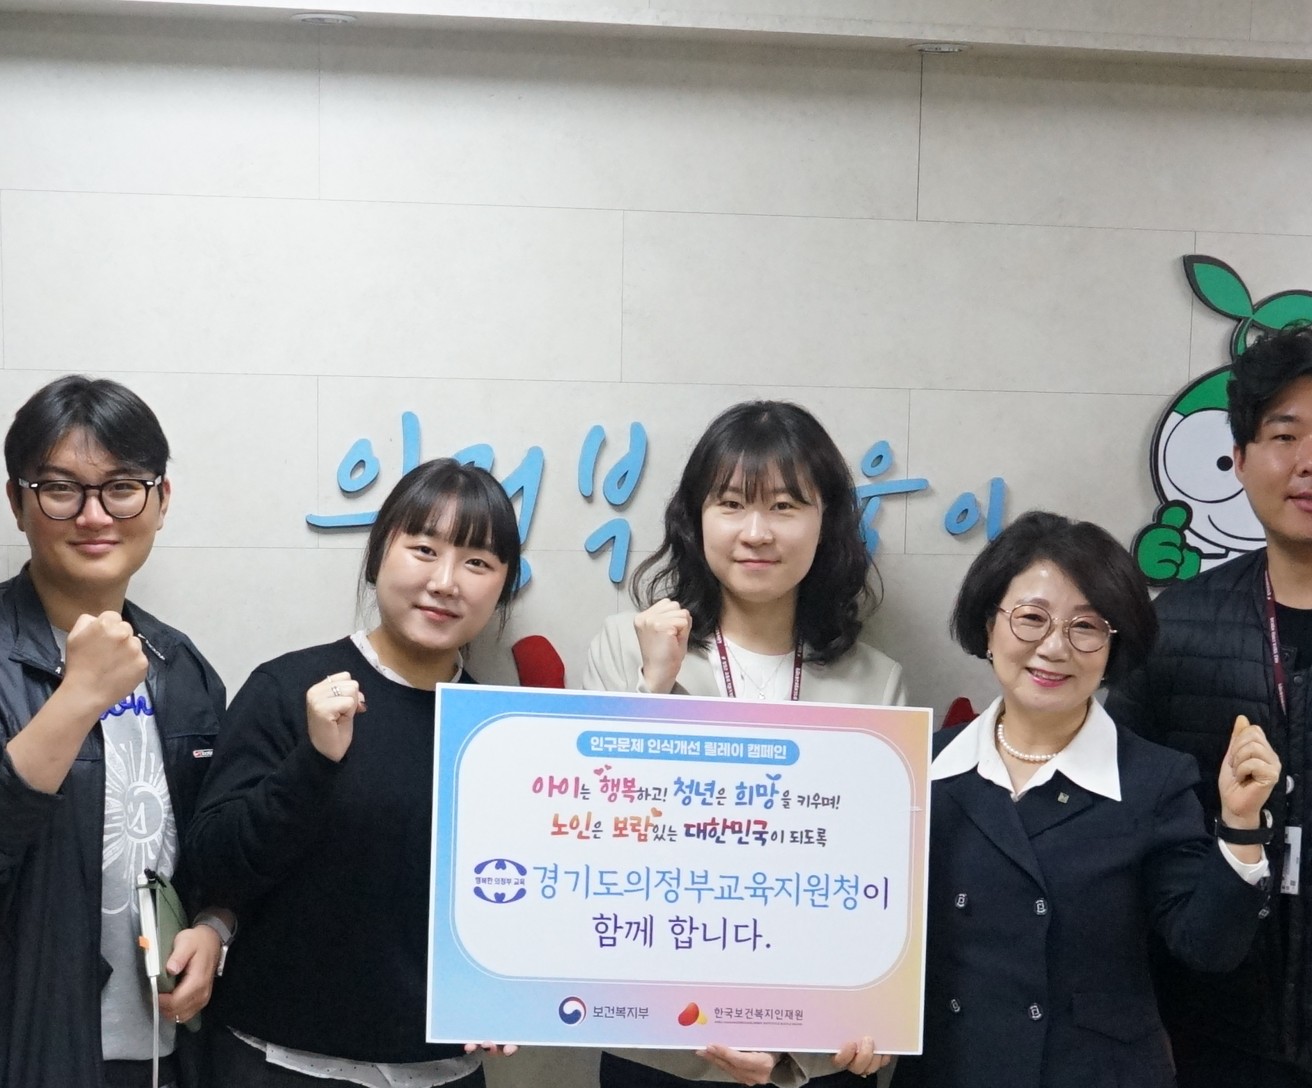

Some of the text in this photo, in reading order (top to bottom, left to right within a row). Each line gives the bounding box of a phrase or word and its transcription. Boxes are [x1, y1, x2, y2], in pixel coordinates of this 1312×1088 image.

[590, 736, 787, 760] 인구문제 인식개선 릴레이 캠페인
[532, 774, 841, 810] 아이는 행복하고! 청년은 희망을 키우며!
[551, 811, 827, 848] 노인은 보람있는 대한민국이 되도록
[533, 862, 889, 911] 경기도의정부교육지원청이
[592, 912, 772, 952] 함께 합니다.
[593, 1005, 649, 1020] 보건복지부
[714, 1006, 804, 1021] 한국보건복지인재원
